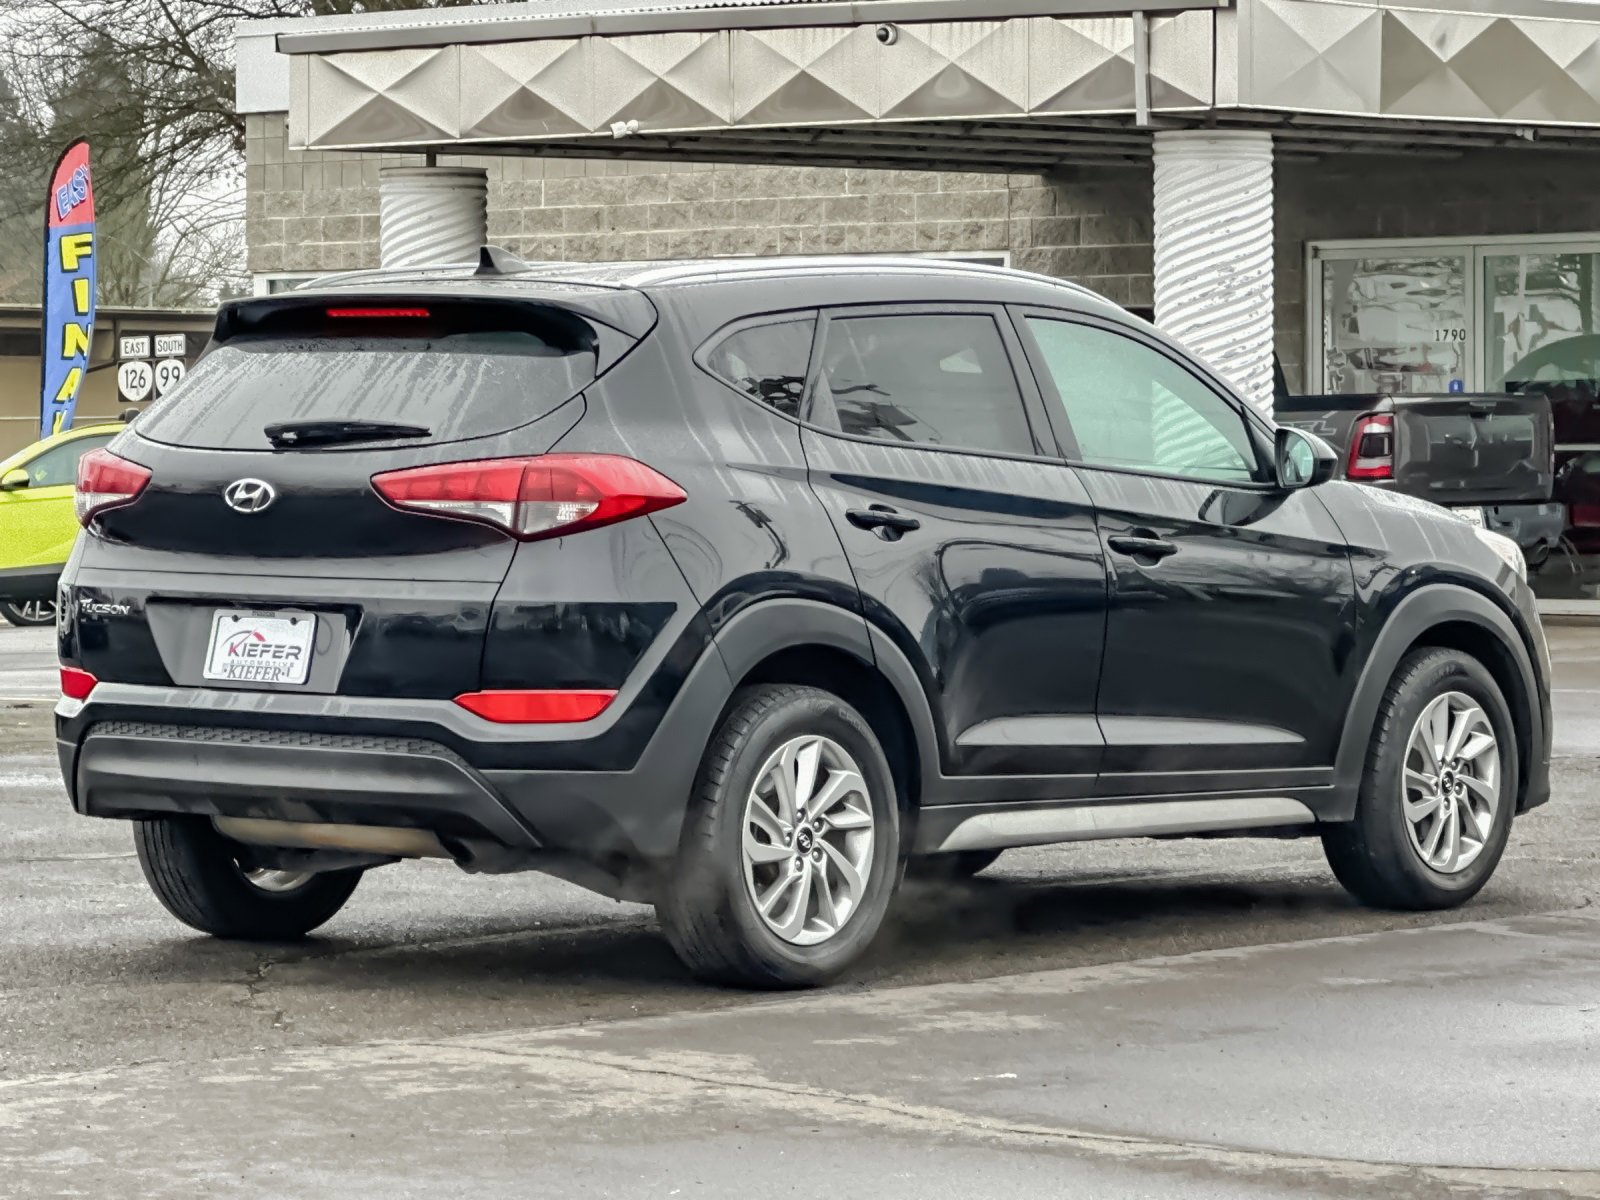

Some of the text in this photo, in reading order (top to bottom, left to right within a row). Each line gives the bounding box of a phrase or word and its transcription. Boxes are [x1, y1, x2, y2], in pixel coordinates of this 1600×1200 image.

[1435, 328, 1466, 342] 1790
[124, 341, 145, 355] EAST
[157, 339, 183, 353] SOUTH
[125, 369, 146, 389] 126
[160, 365, 181, 388] 99
[80, 598, 130, 616] TUCSON
[227, 641, 302, 660] KIEFER
[226, 664, 281, 681] KIEFER
